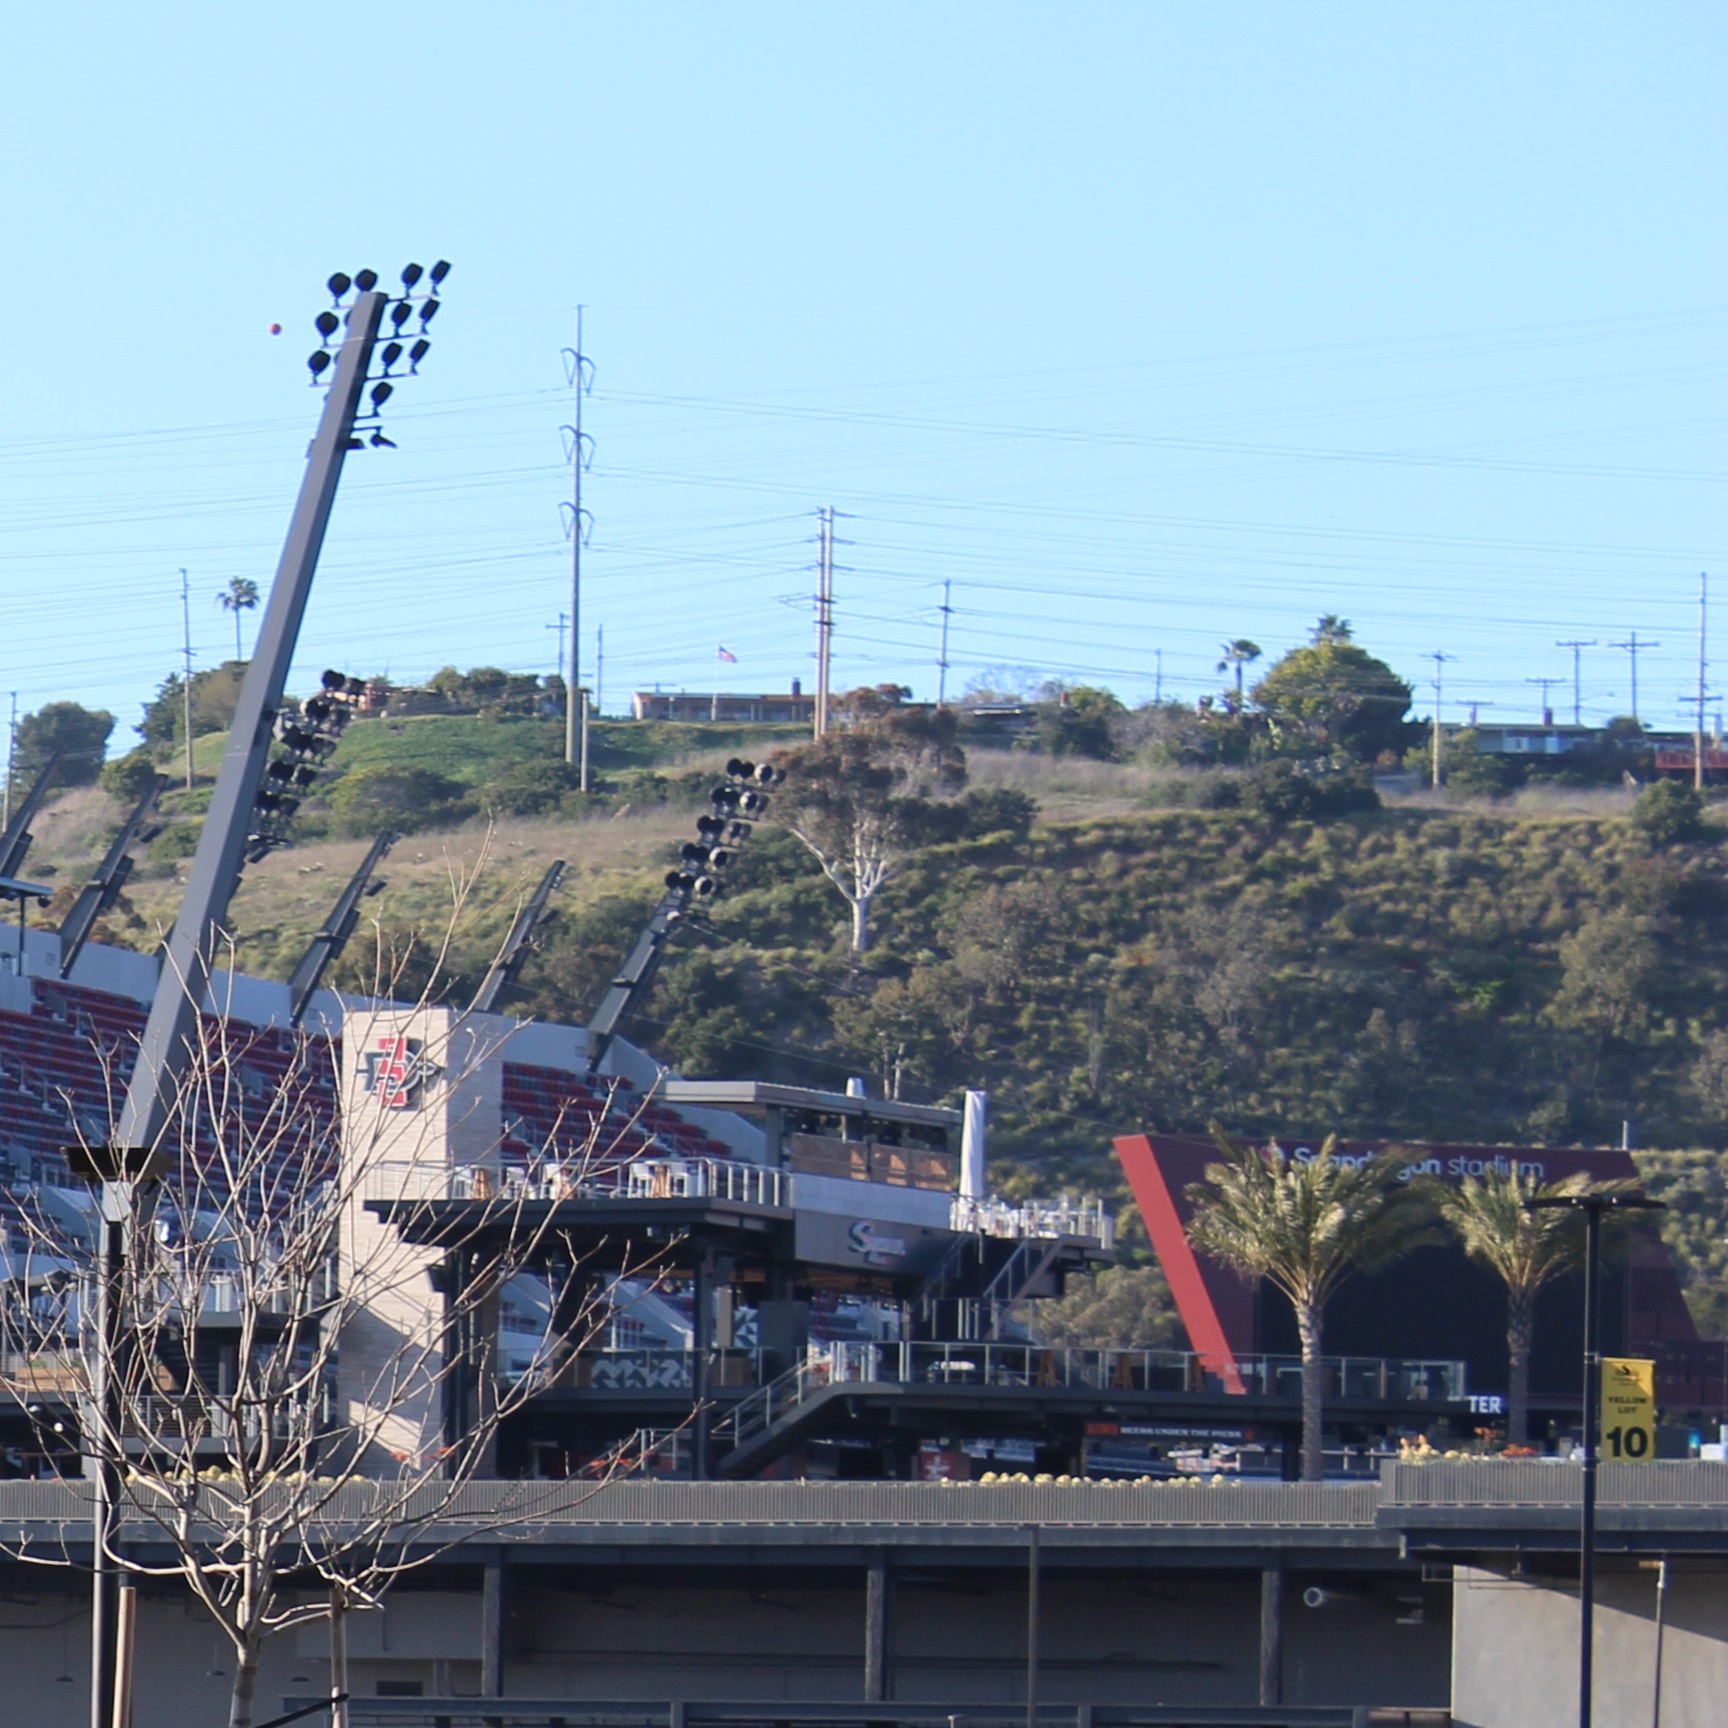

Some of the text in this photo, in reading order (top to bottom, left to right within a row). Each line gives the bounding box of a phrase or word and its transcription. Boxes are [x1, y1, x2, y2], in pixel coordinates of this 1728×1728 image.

[1608, 1396, 1646, 1404] YELLOW
[1618, 1406, 1637, 1414] LOT
[1606, 1426, 1648, 1458] 10
